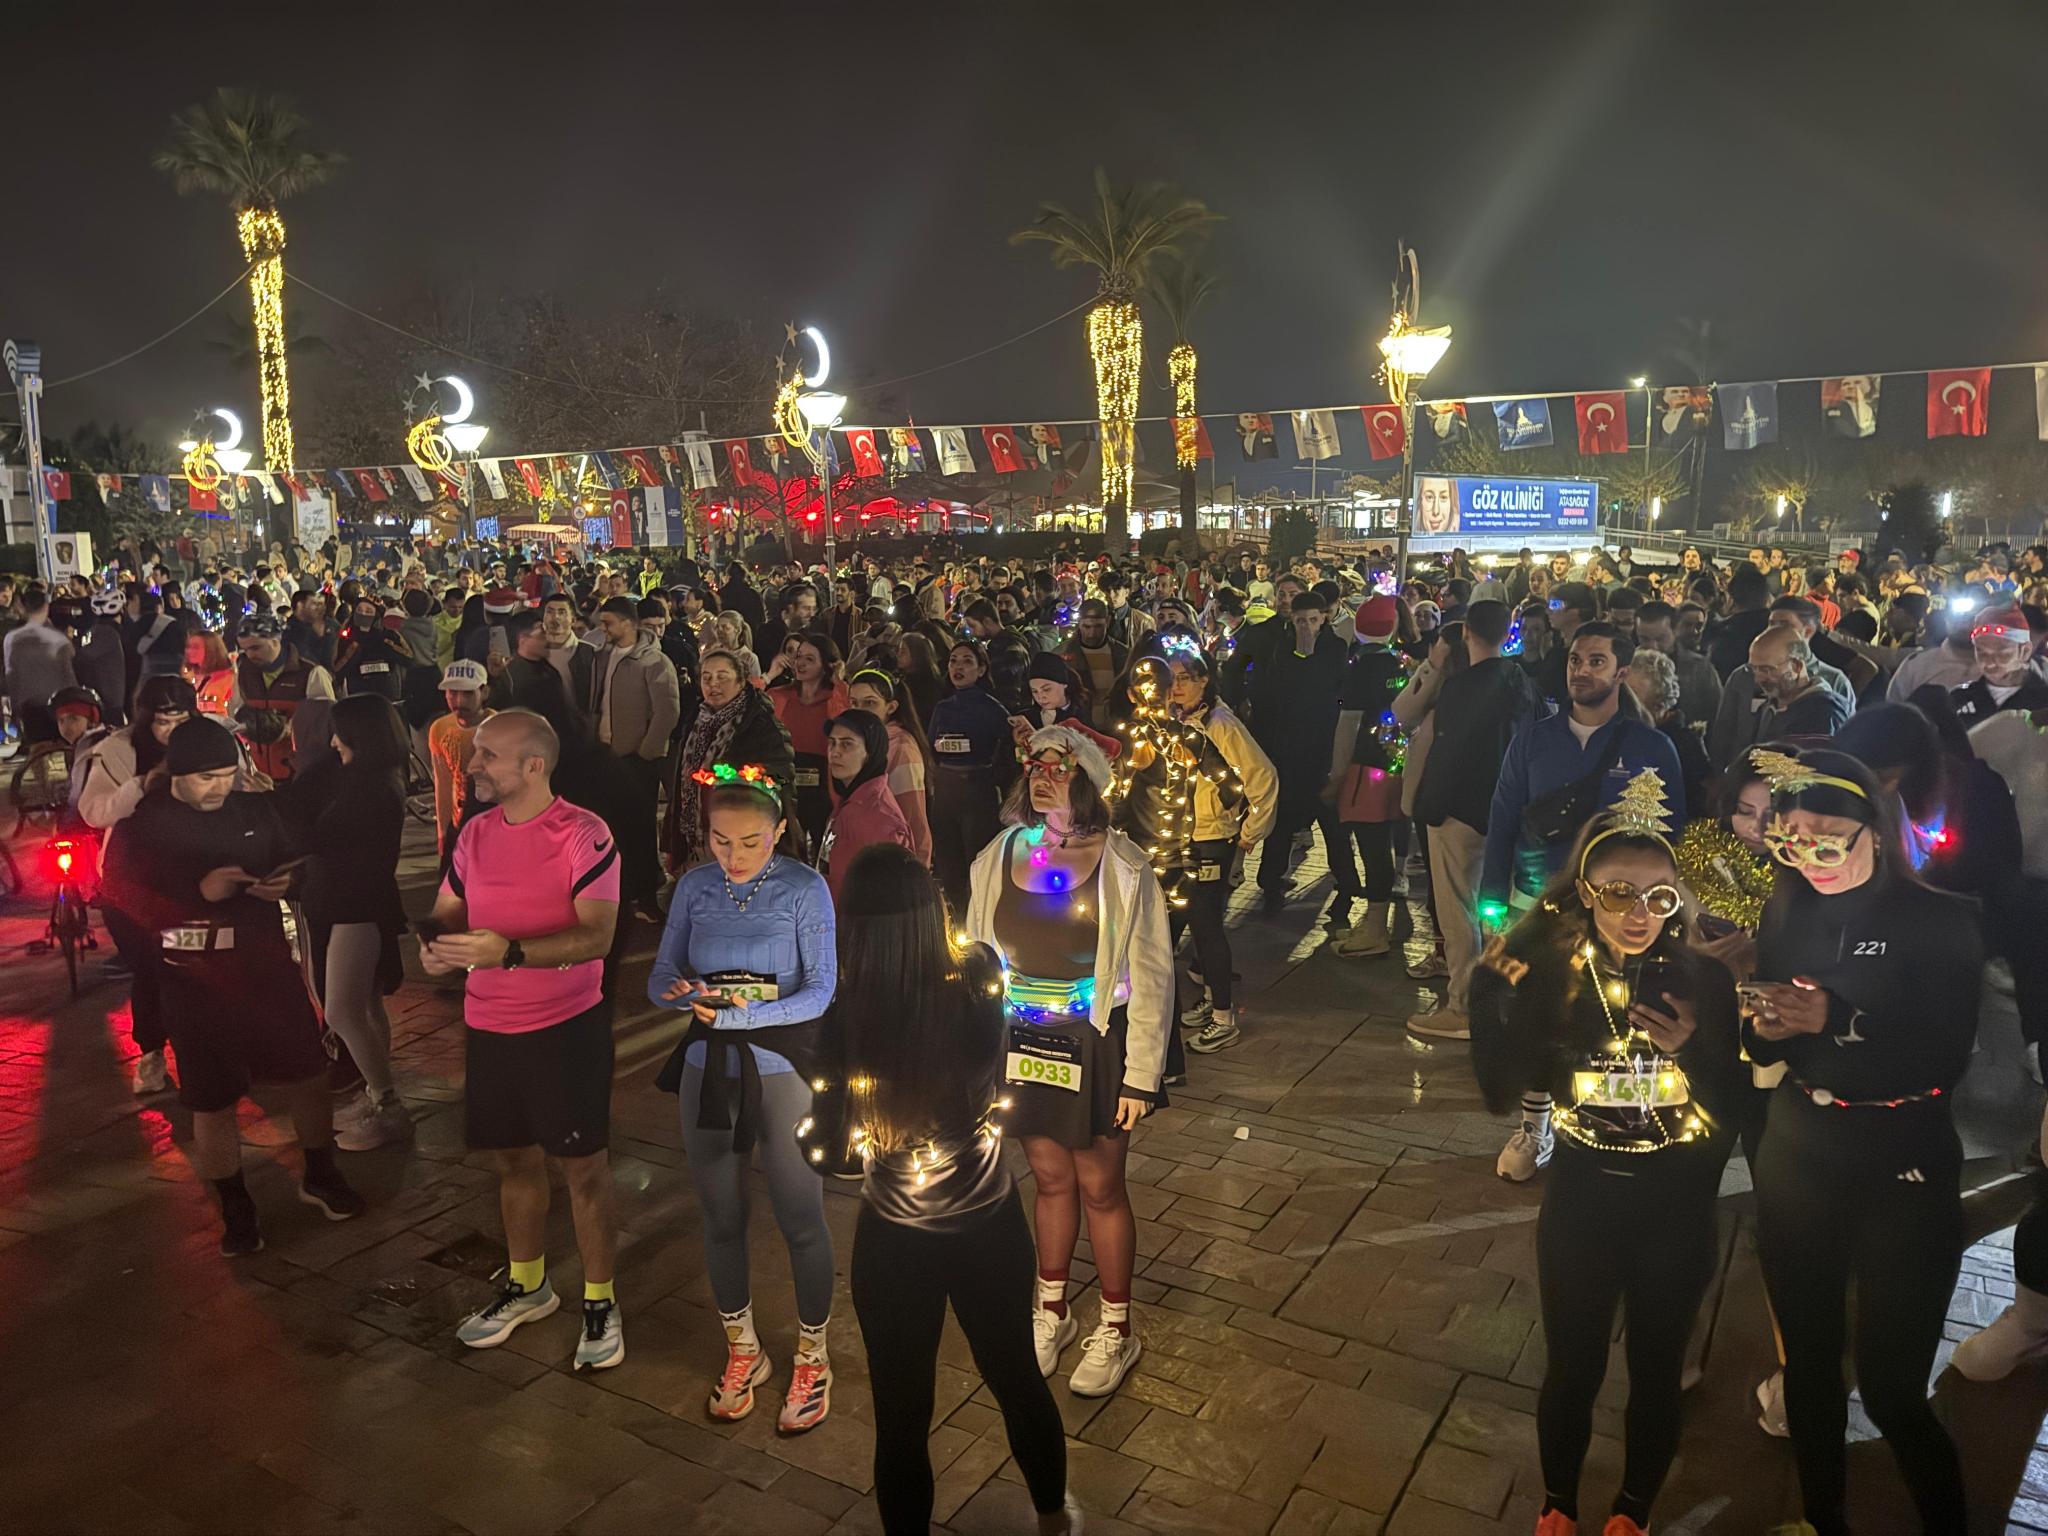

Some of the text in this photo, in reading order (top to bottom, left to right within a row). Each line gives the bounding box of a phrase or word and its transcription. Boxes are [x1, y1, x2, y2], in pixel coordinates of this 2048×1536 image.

[1472, 484, 1544, 510] GÖZ KLİNİĞİ
[1853, 940, 1887, 956] 221
[1019, 1058, 1071, 1085] 0933
